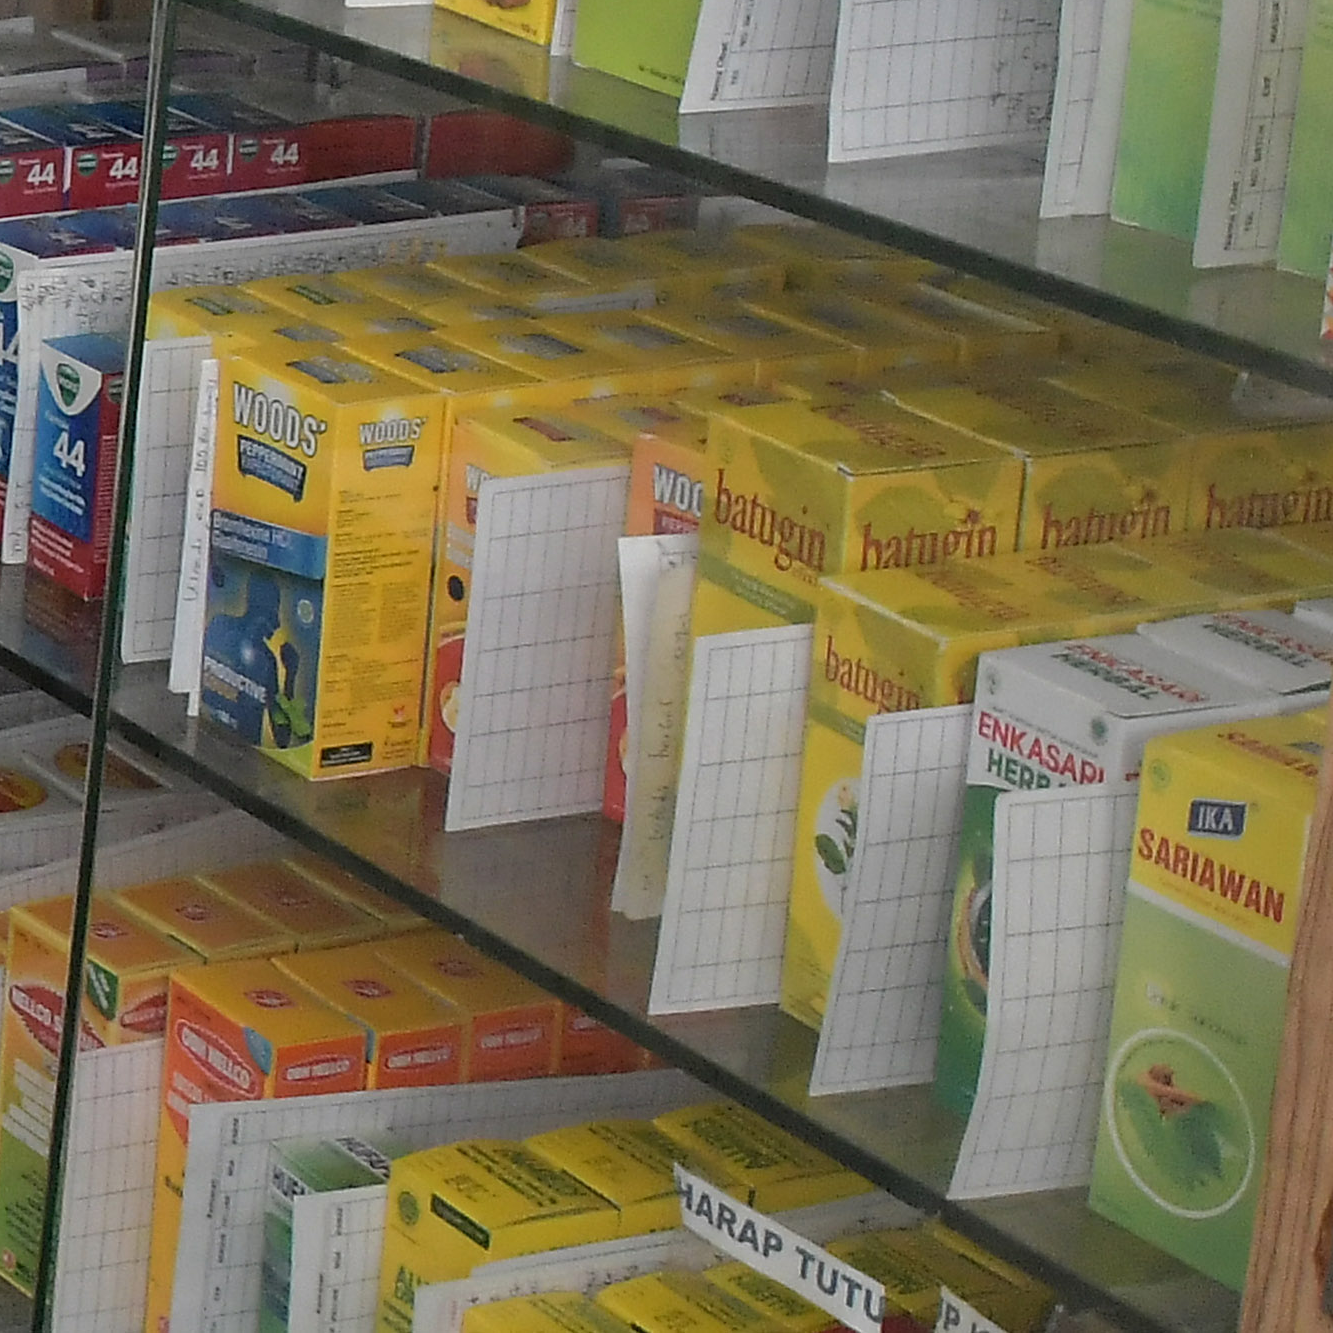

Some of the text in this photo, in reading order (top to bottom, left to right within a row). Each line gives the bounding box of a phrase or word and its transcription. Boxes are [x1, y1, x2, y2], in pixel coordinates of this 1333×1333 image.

[27, 163, 56, 185] 44
[109, 156, 138, 179] 44
[190, 149, 219, 171] 44
[270, 142, 300, 165] 44
[53, 431, 86, 477] 44
[653, 463, 704, 518] WOO
[714, 469, 828, 573] batugin
[824, 635, 921, 714] batugin
[1197, 804, 1234, 832] IKA
[1137, 827, 1286, 924] SARIAWAN
[677, 1179, 883, 1322] HARAP TUTU
